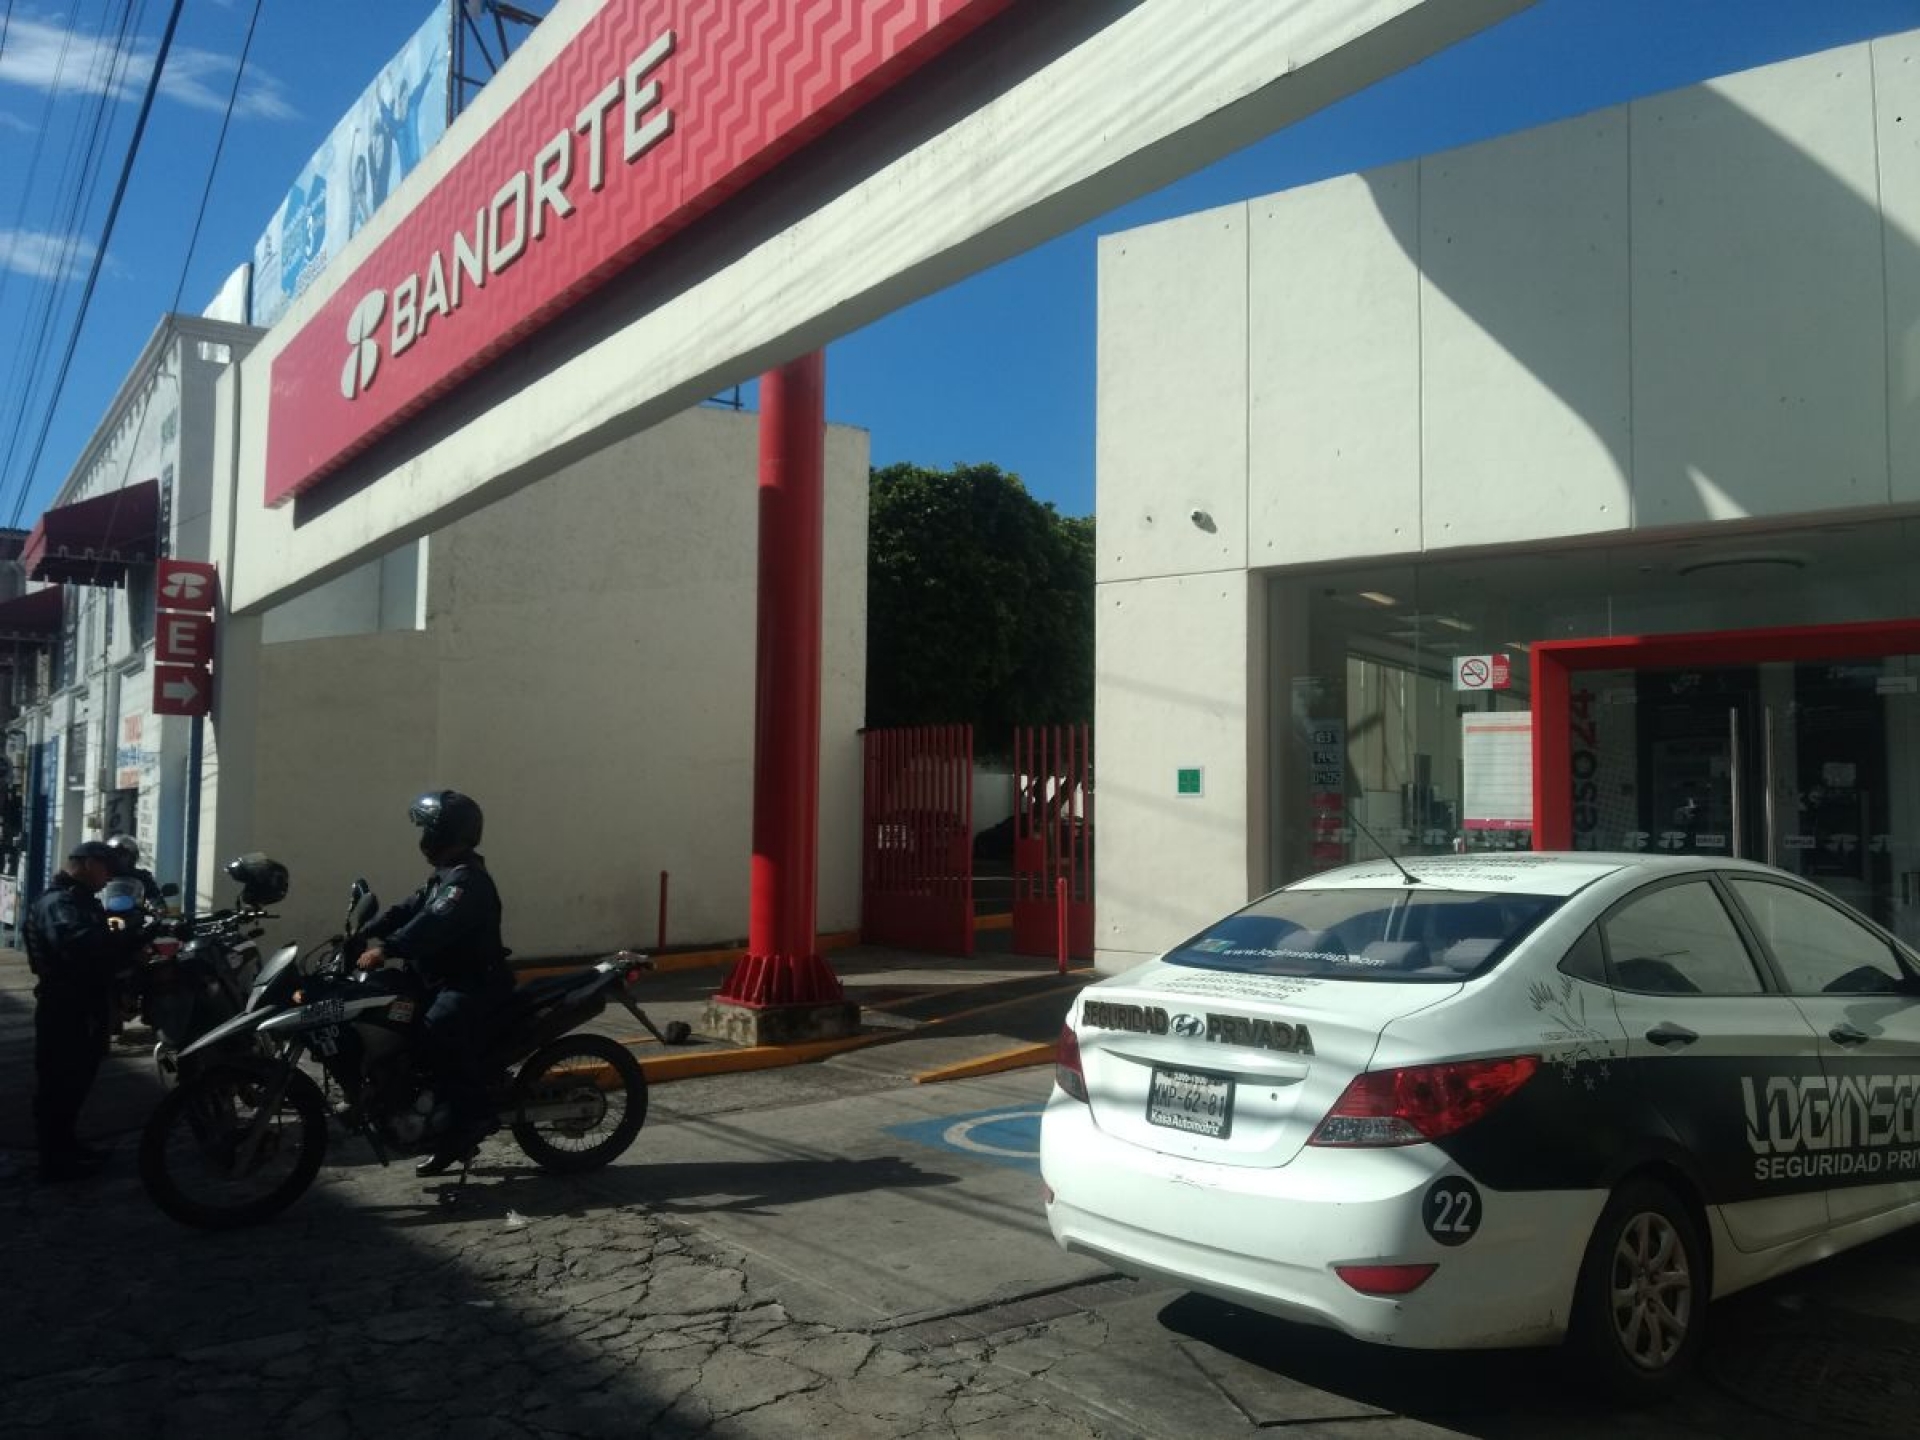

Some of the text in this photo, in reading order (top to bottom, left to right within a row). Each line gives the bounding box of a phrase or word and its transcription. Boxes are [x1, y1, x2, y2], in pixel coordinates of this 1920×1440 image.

[391, 29, 677, 357] BANORTE
[168, 621, 197, 655] E
[1082, 1000, 1315, 1056] SEGURIDAD PRIVADA
[1754, 1149, 1920, 1180] SEGURIDAD PRI
[1434, 1190, 1473, 1233] 22
